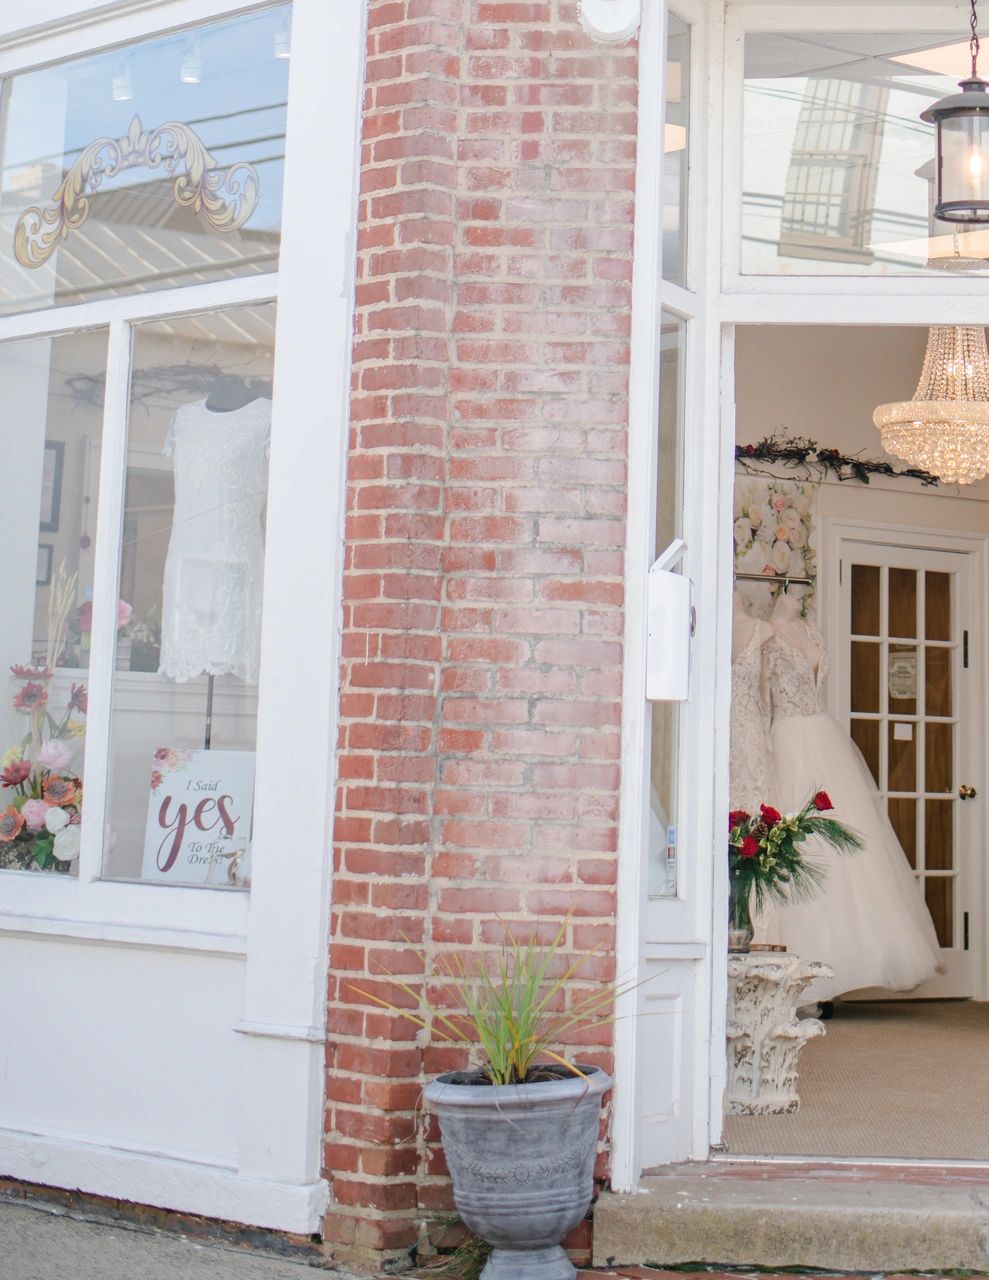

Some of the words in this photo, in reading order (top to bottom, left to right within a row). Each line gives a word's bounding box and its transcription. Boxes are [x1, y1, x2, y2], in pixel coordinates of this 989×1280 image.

[186, 780, 193, 791] I
[194, 779, 222, 792] Said
[157, 795, 241, 872] yes
[188, 841, 203, 853] To
[187, 854, 224, 865] Dres!
